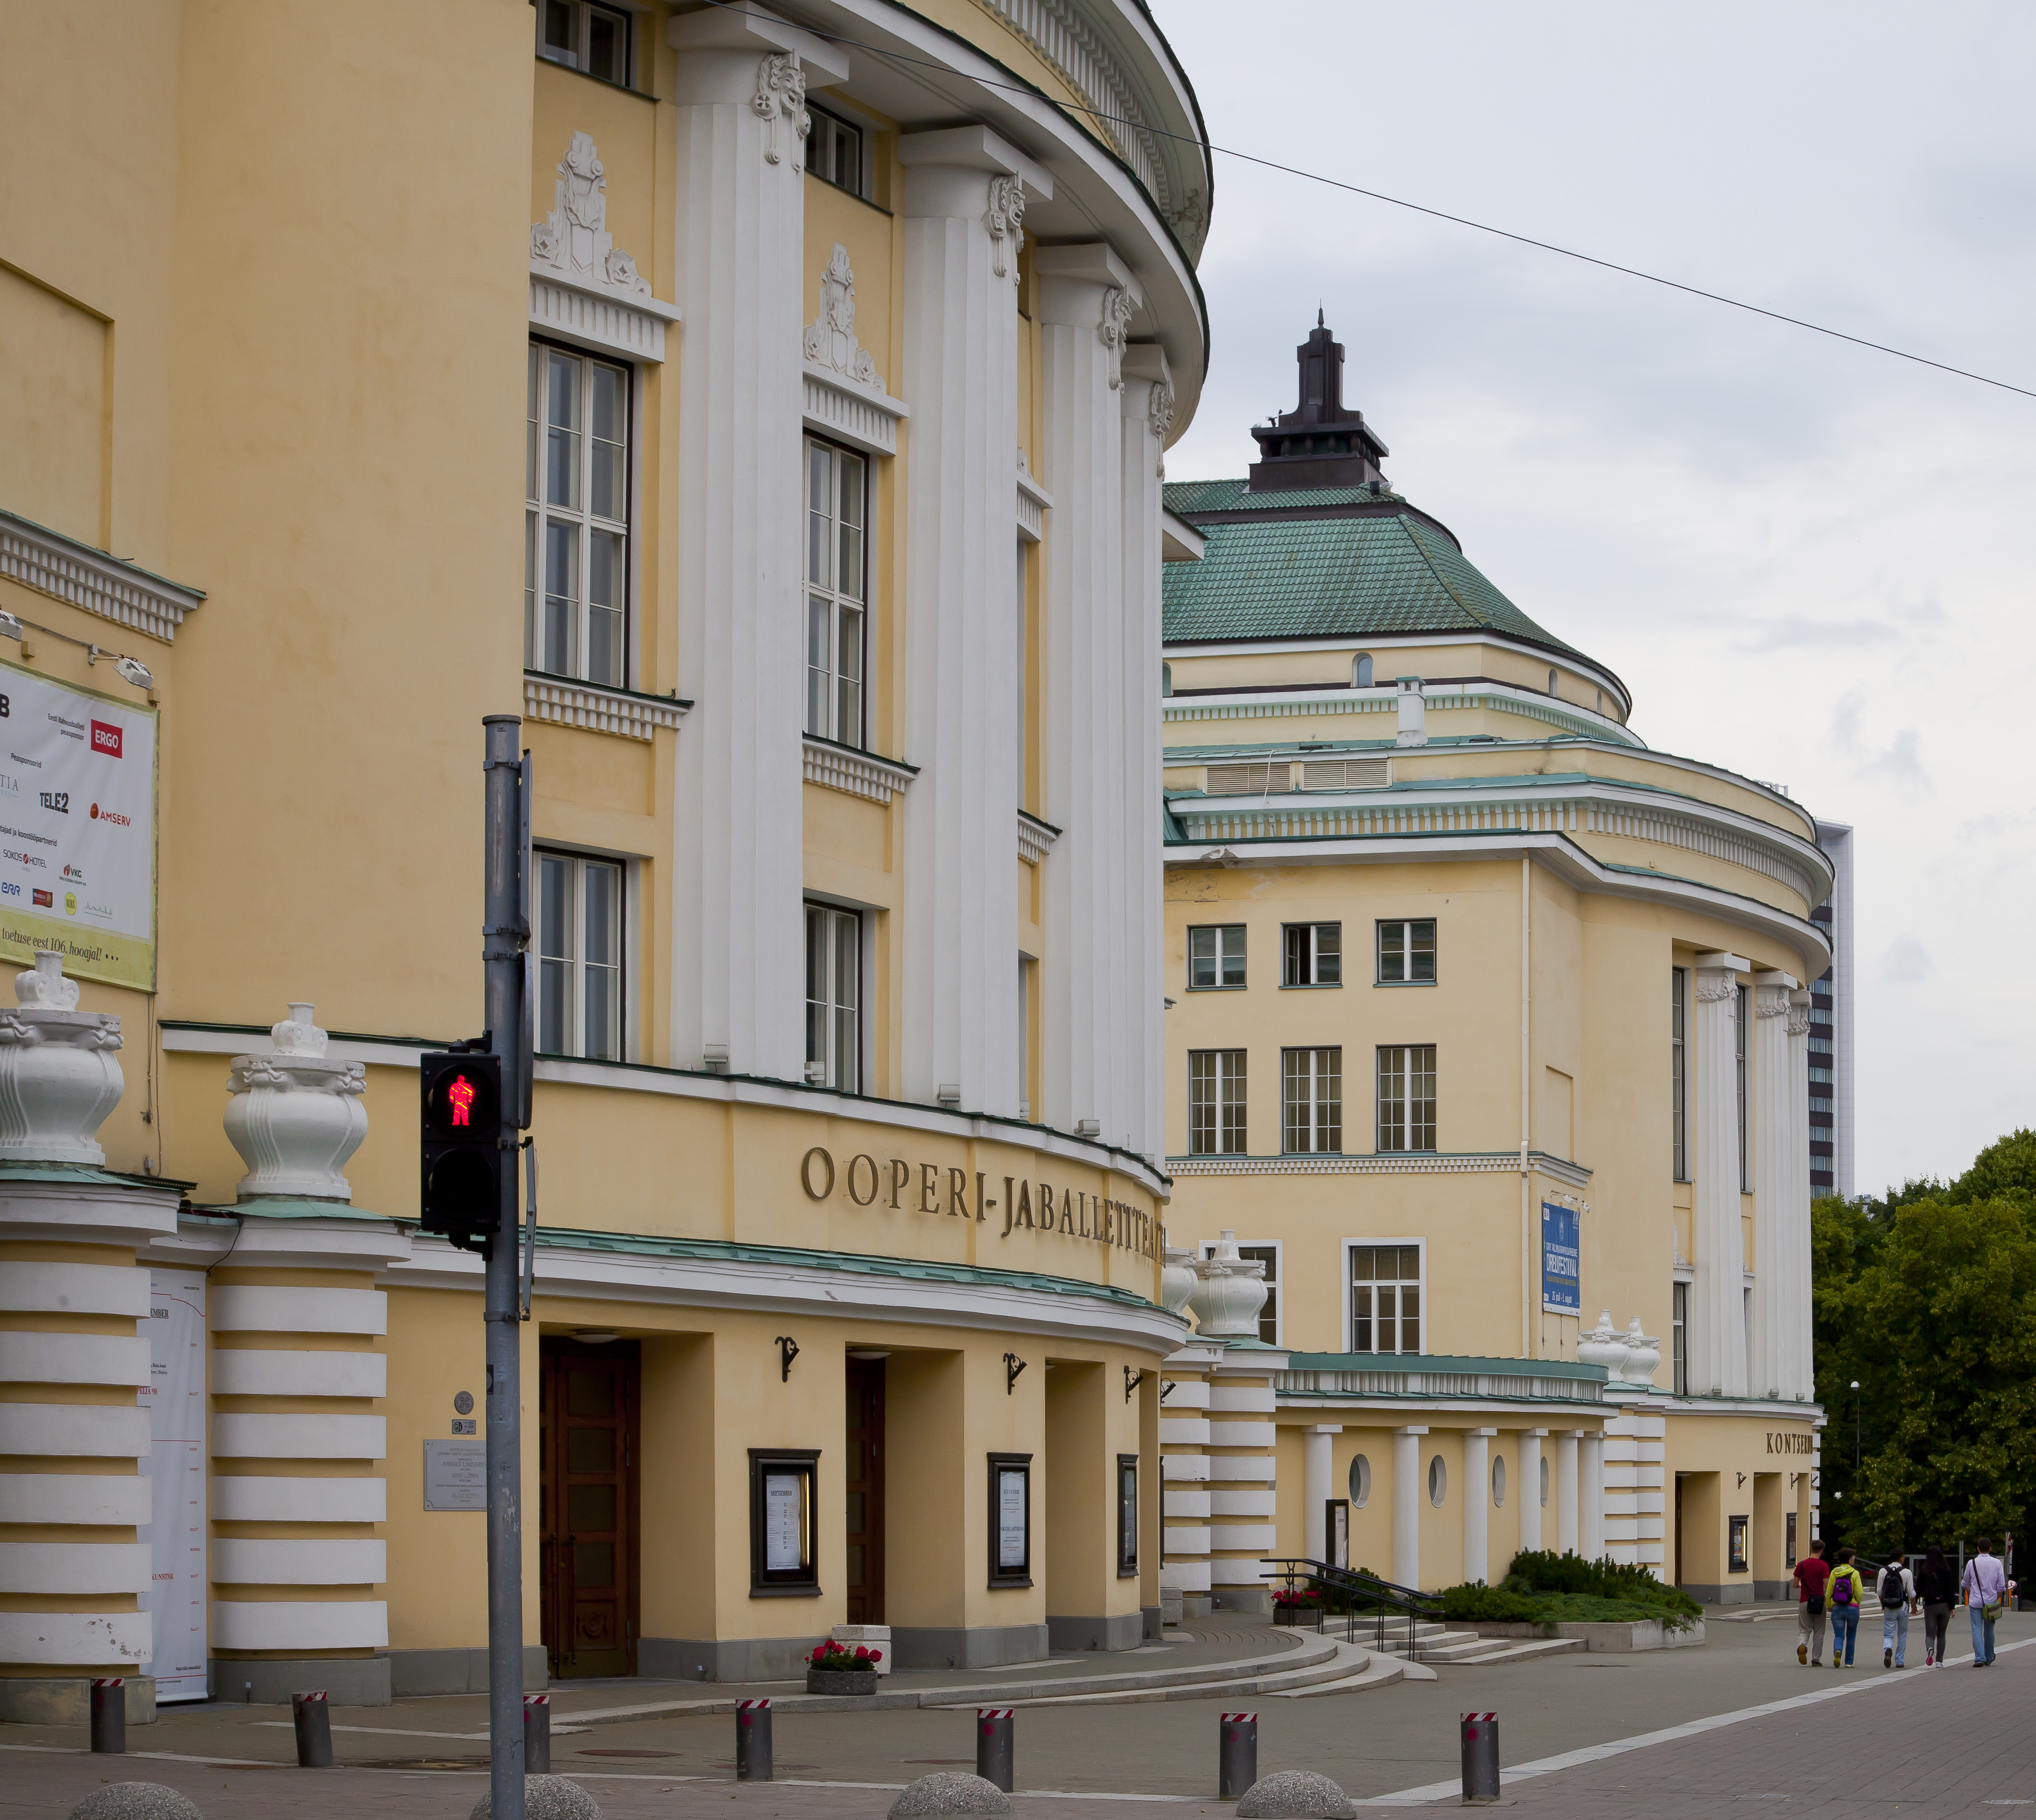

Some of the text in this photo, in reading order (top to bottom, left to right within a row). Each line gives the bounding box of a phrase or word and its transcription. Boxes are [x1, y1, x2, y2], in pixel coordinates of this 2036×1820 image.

[61, 729, 84, 740] peasponsor
[95, 729, 119, 749] ERGO
[11, 752, 42, 769] Peasponsorid
[40, 792, 69, 814] TELE2
[100, 810, 131, 827] AMSERV
[3, 849, 48, 868] SOKOS HOTEL
[70, 868, 82, 878] VKG
[2, 927, 102, 962] toetuse eest 106. hooajal!
